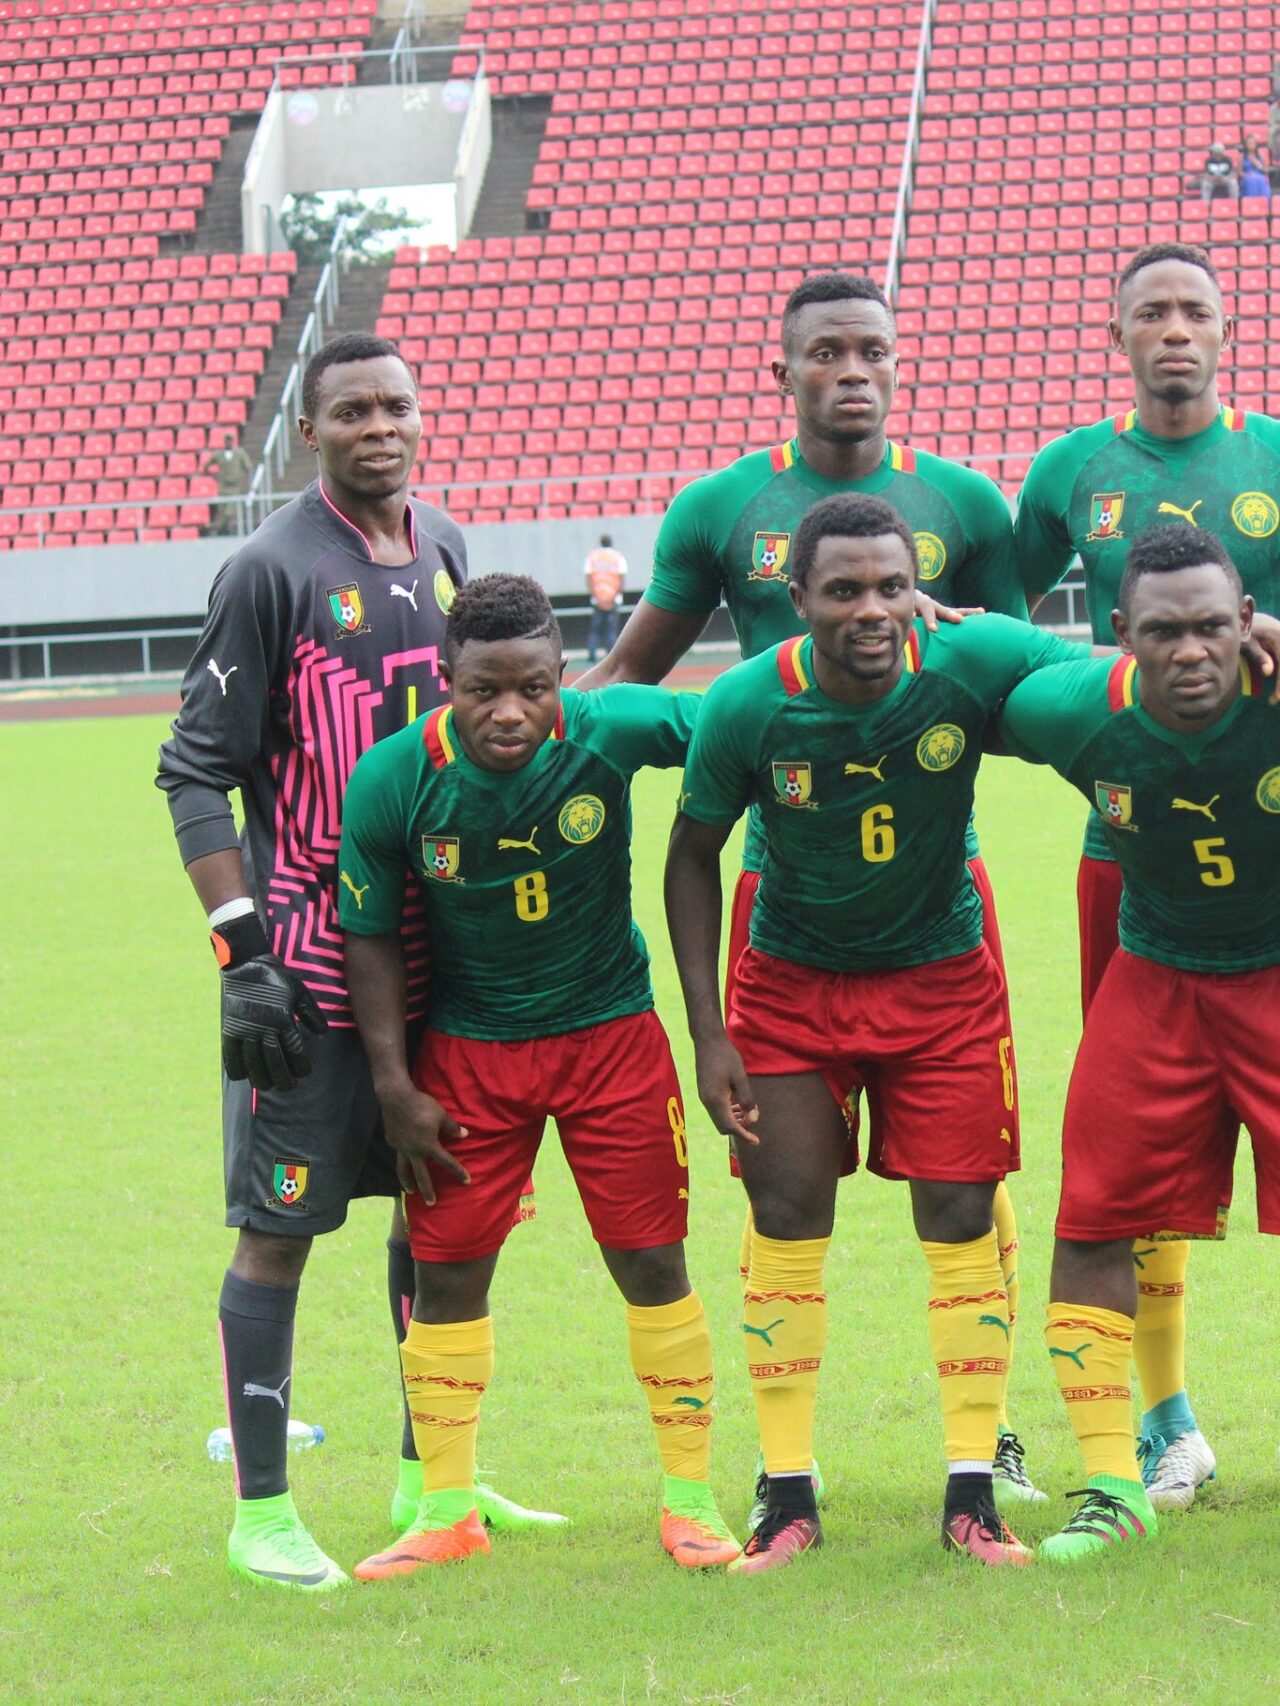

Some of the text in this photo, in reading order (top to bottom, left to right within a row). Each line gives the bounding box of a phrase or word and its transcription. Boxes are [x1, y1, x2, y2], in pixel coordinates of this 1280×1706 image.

[861, 803, 896, 864] 6
[1192, 836, 1235, 886] 5
[513, 870, 549, 923] 8
[668, 1097, 689, 1168] 8
